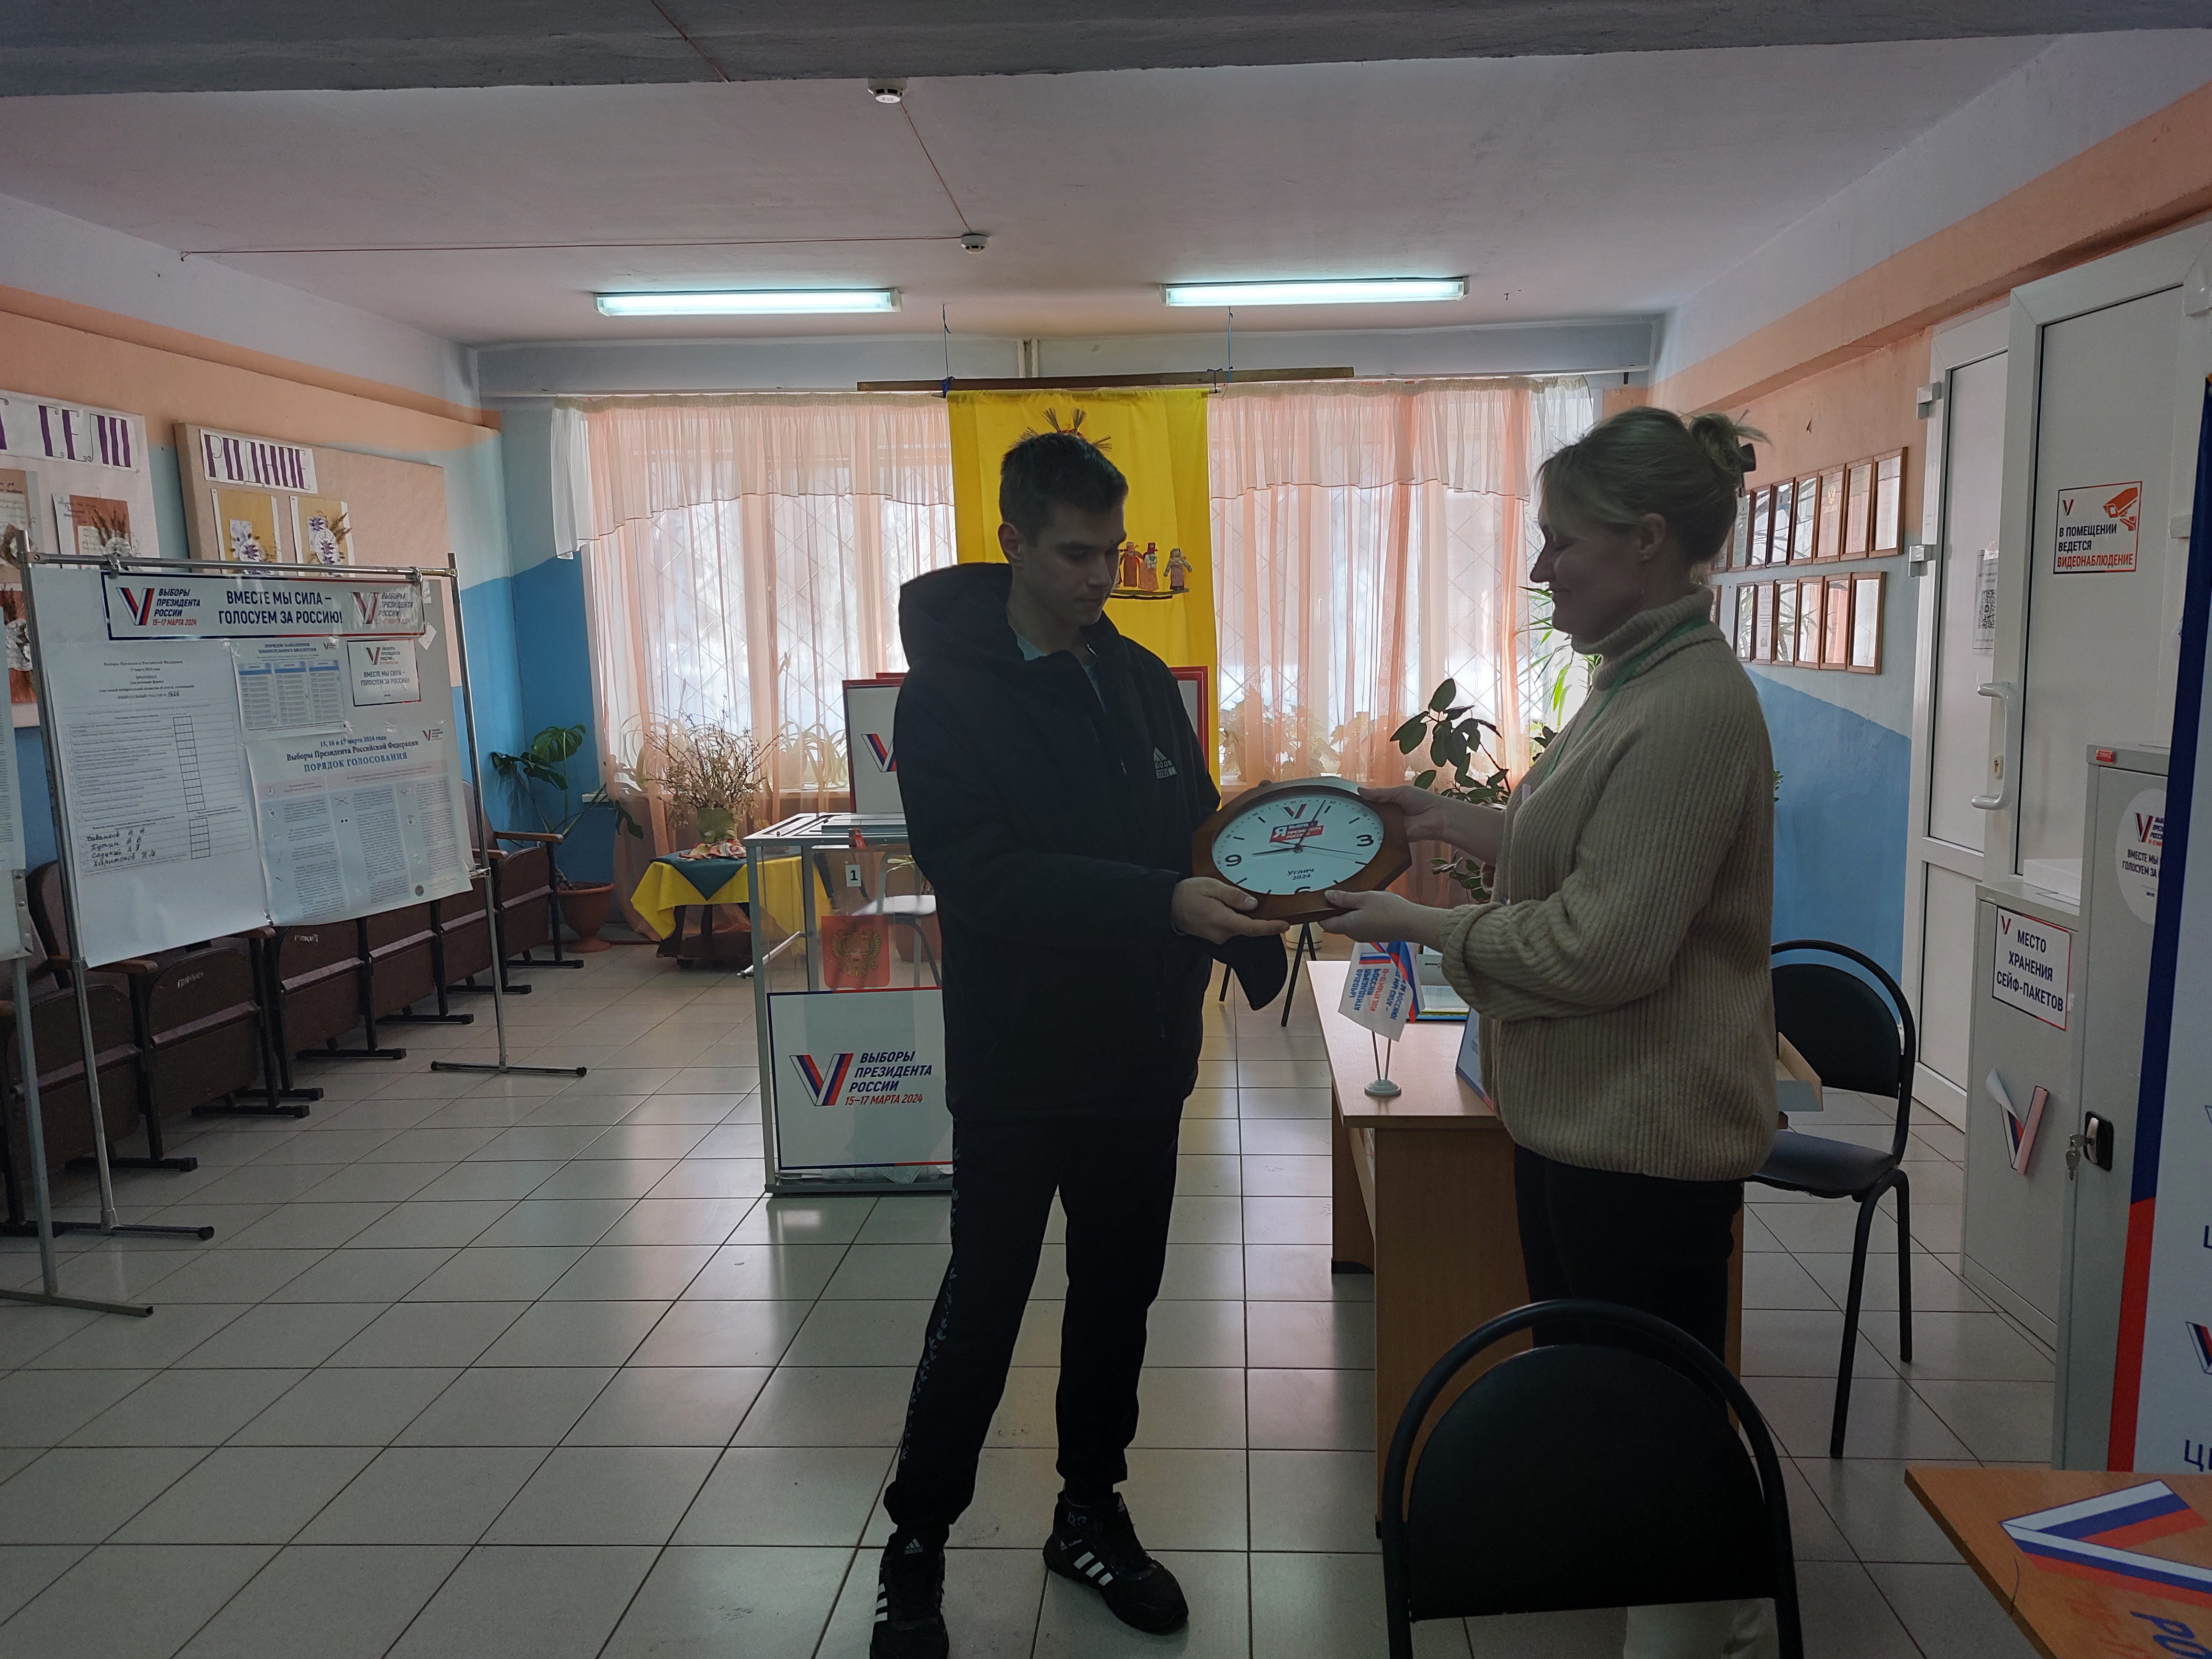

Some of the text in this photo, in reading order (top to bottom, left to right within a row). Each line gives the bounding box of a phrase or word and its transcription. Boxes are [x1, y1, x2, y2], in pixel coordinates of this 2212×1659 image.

[38, 405, 132, 468] СЕЛО
[204, 434, 311, 490] РОДНОЕ
[2059, 524, 2117, 537] В ПОМЕЩЕНИИ
[2058, 541, 2091, 553] ВЕДЕТСЯ
[2057, 553, 2133, 570] ВИДЕОНАБЛЮДЕНИЕ
[158, 588, 190, 597] ВЫБОРЫ
[226, 590, 269, 605] ВМЕСТЕ
[273, 592, 292, 605] МЫ
[295, 592, 323, 605] СИЛА
[156, 599, 200, 608] ПРЕЗИДЕНТА
[154, 609, 182, 617] РОССИИ
[219, 610, 343, 624] ГОЛОСУЕМ ЗА РОССИЮ!
[287, 741, 419, 762] Выборы Президента Российской Федерации
[304, 752, 408, 772] ПОРЯДОК ГОЛОСОВАНИЯ
[1272, 826, 1287, 839] Я
[1356, 834, 1374, 846] 3
[1225, 855, 1242, 866] 9
[2127, 849, 2158, 865] ВМЕСТЕ МЫ
[850, 870, 858, 881] 1
[2123, 861, 2157, 878] ГОЛОСУЕМ ЗА
[2017, 929, 2046, 953] МЕСТО
[2009, 951, 2053, 982] ХРАНЕНИЯ
[1996, 971, 2063, 1012] СЕЙФ-ПАКЕТОВ
[860, 1051, 916, 1063] ВЫБОРЫ
[854, 1065, 932, 1078] ПРЕЗИДЕНТА
[849, 1081, 899, 1093] РОССИИ
[870, 1095, 900, 1105] МАРТА
[902, 1094, 923, 1103] 2024
